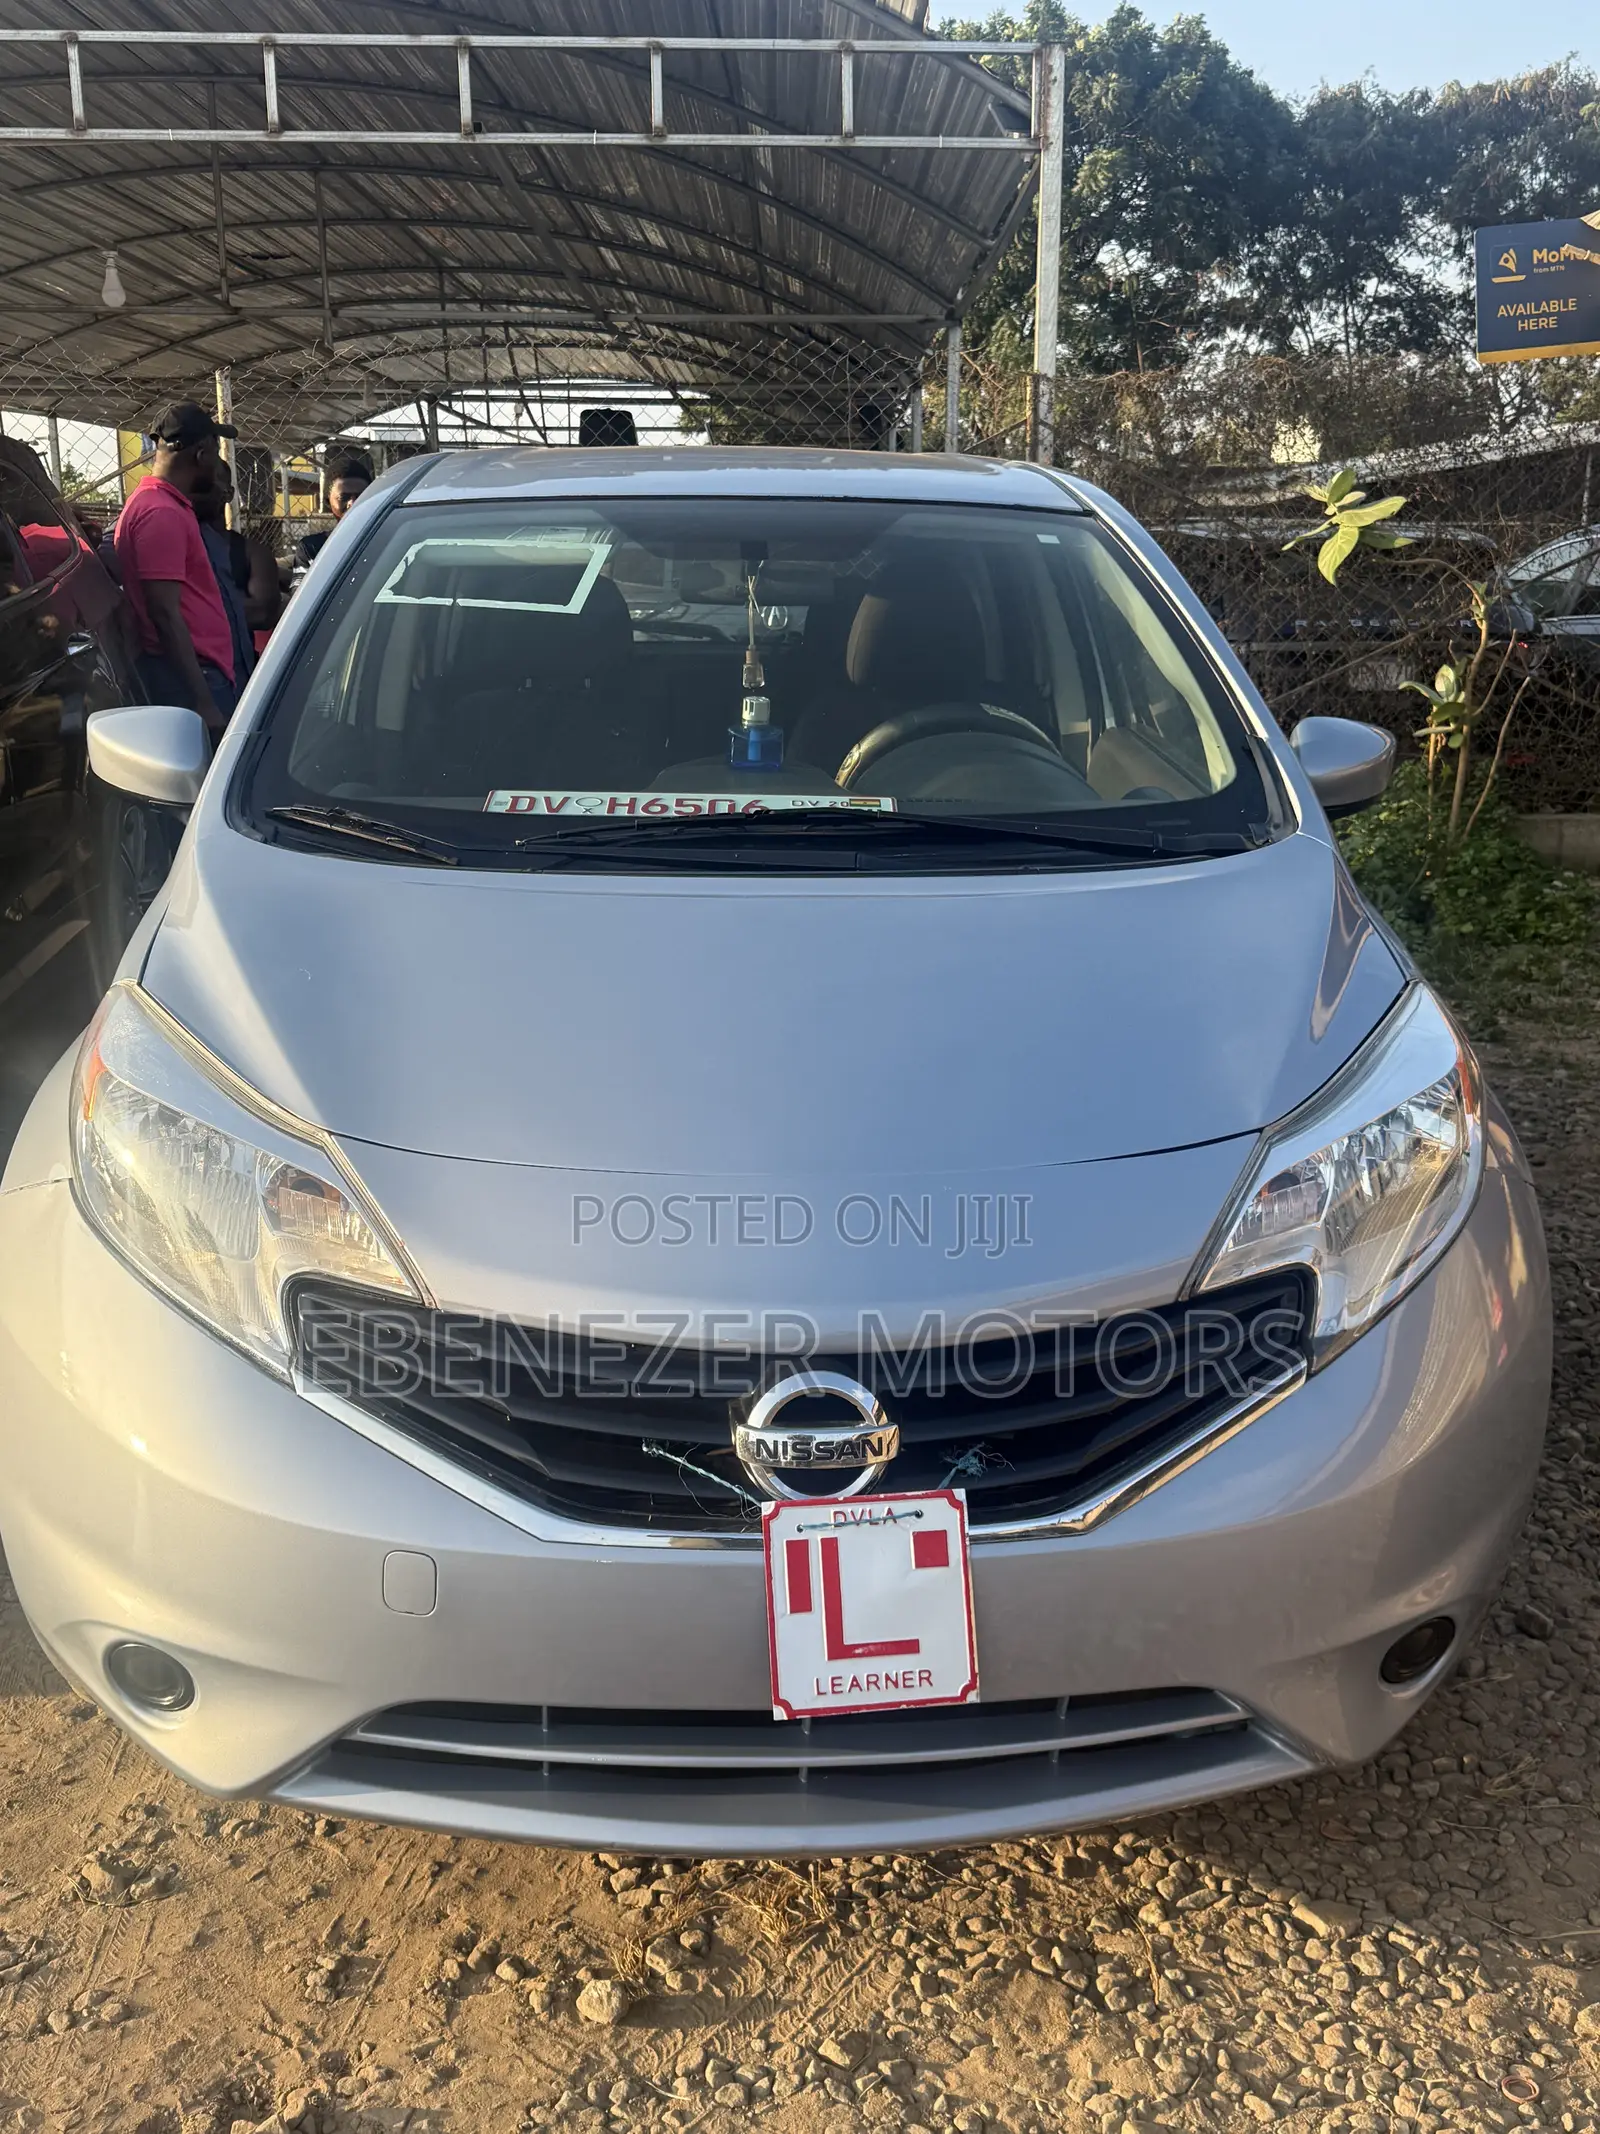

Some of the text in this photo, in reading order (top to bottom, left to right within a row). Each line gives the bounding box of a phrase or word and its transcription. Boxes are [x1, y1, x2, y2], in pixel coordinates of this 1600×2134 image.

[1497, 298, 1578, 318] AVAILABLE
[1517, 316, 1558, 331] HERE
[504, 795, 571, 813] DV
[754, 1437, 884, 1462] NISSAN
[832, 1507, 898, 1529] DVLA
[813, 1668, 935, 1697] LEARNER
